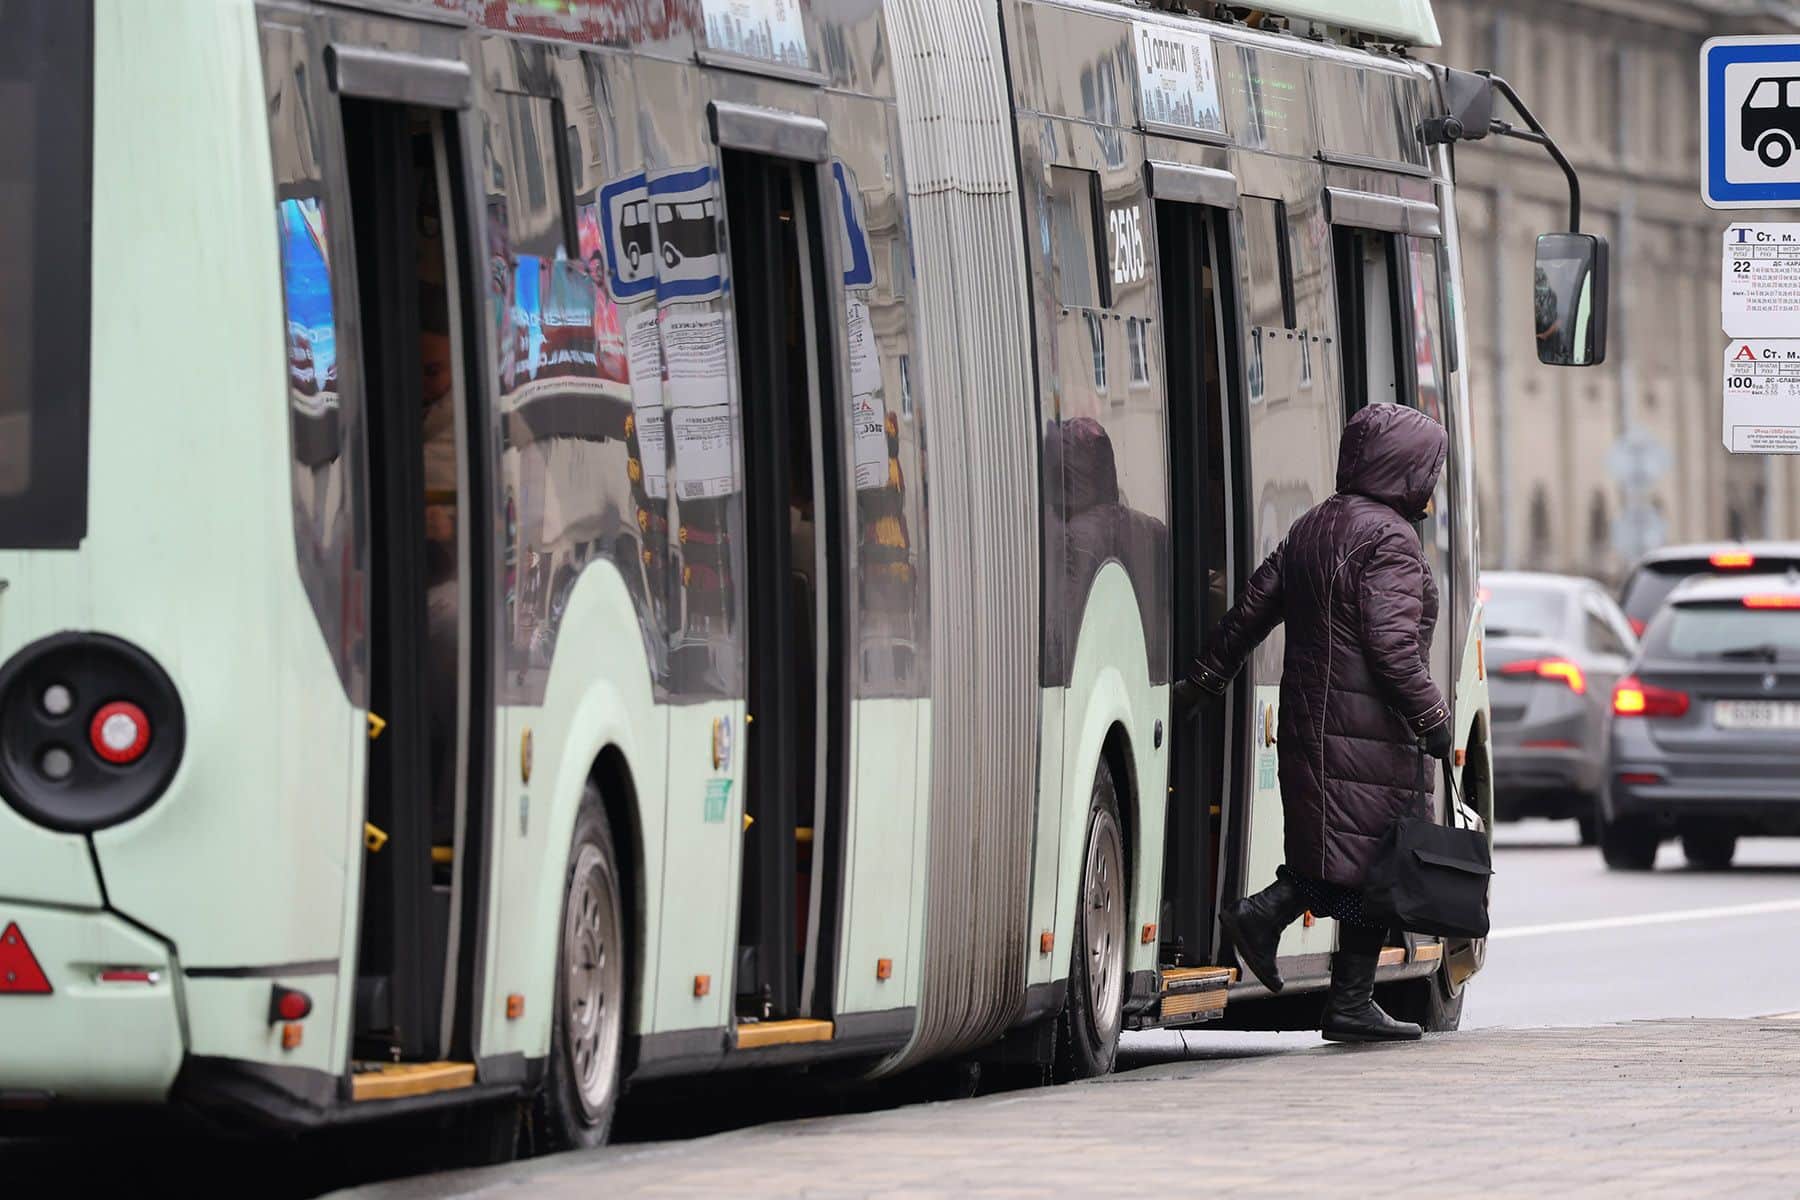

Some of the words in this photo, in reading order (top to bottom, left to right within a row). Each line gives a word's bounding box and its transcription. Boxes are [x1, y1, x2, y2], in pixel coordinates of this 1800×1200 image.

[1731, 228, 1754, 243] Т
[1756, 231, 1776, 242] Ст.
[1782, 234, 1797, 242] м.
[1110, 206, 1145, 284] 2505
[1733, 261, 1751, 273] 22
[1733, 344, 1757, 360] А
[1763, 348, 1781, 359] Ст.
[1727, 377, 1752, 388] 100
